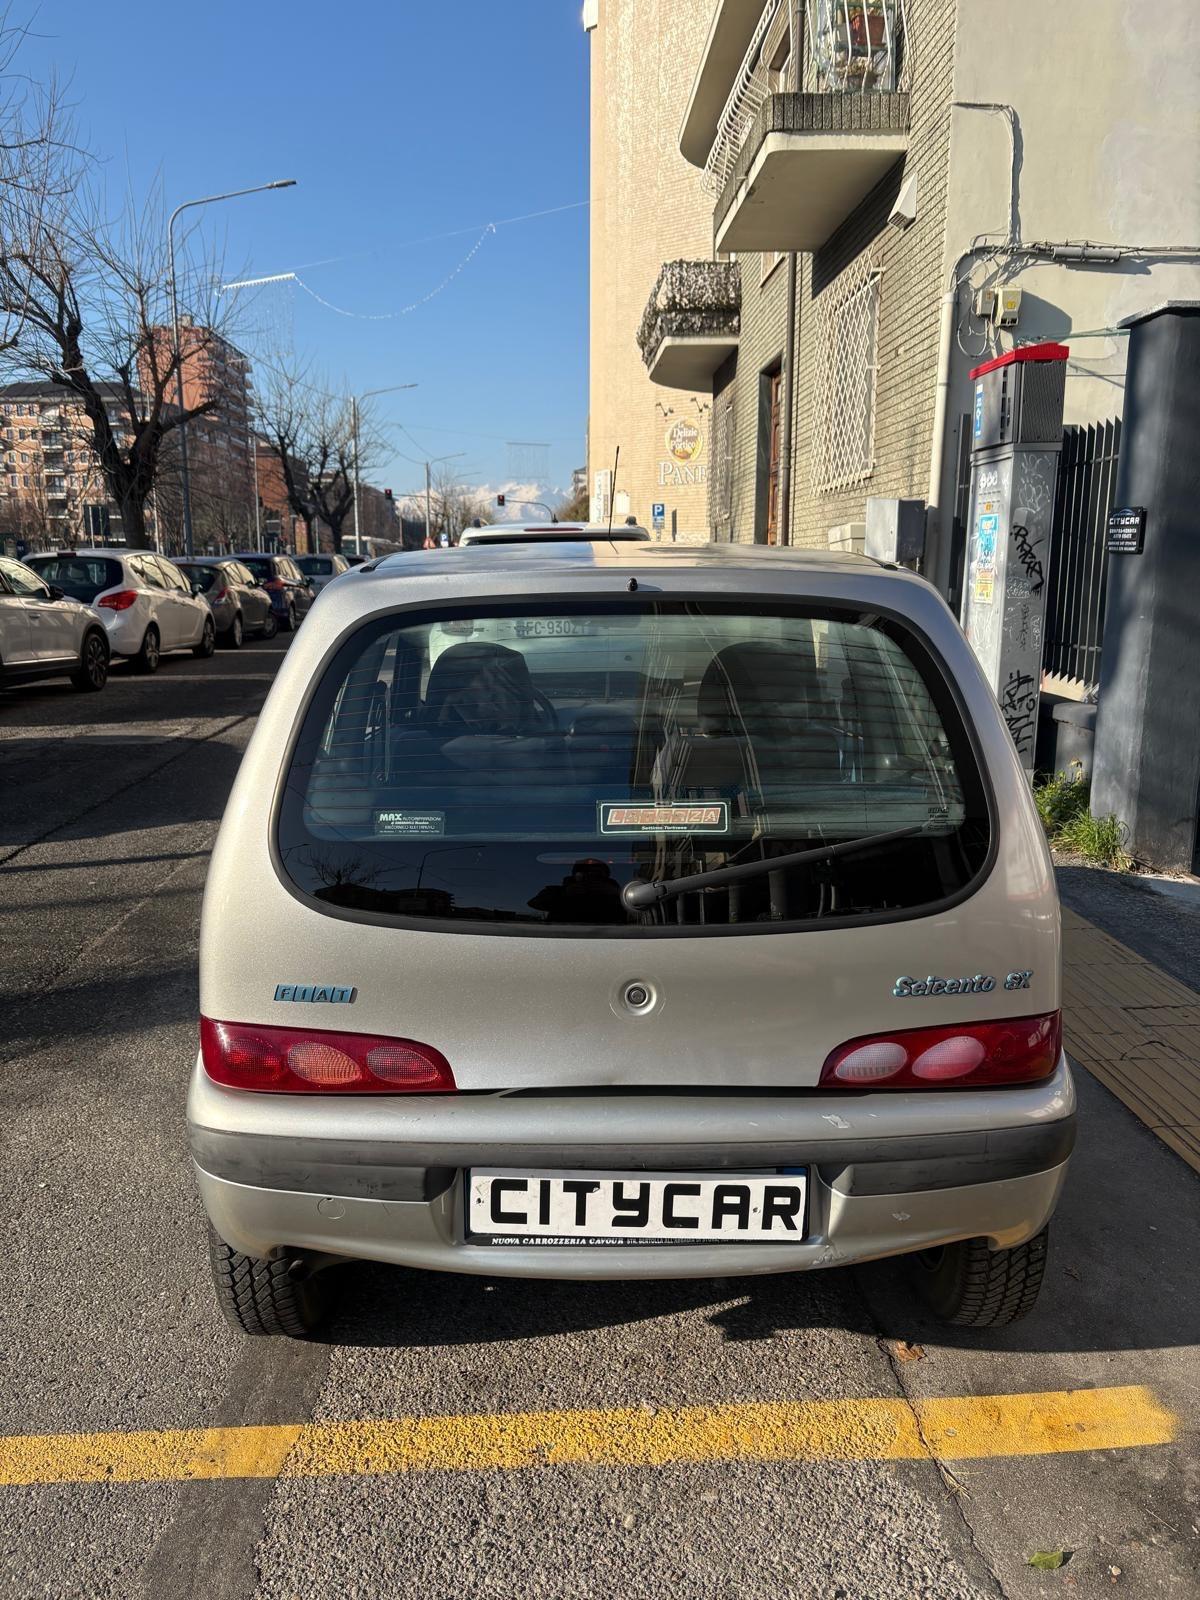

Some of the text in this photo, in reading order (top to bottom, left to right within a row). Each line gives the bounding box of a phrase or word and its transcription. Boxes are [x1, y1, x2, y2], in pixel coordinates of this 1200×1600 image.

[673, 427, 698, 438] Delizie
[671, 440, 696, 450] Portico
[654, 504, 663, 516] P
[1109, 517, 1140, 525] CITYCAR
[380, 813, 402, 821] MAX
[893, 975, 996, 997] Seicento
[276, 986, 352, 1002] FIAT
[490, 1178, 801, 1230] CITYCAR
